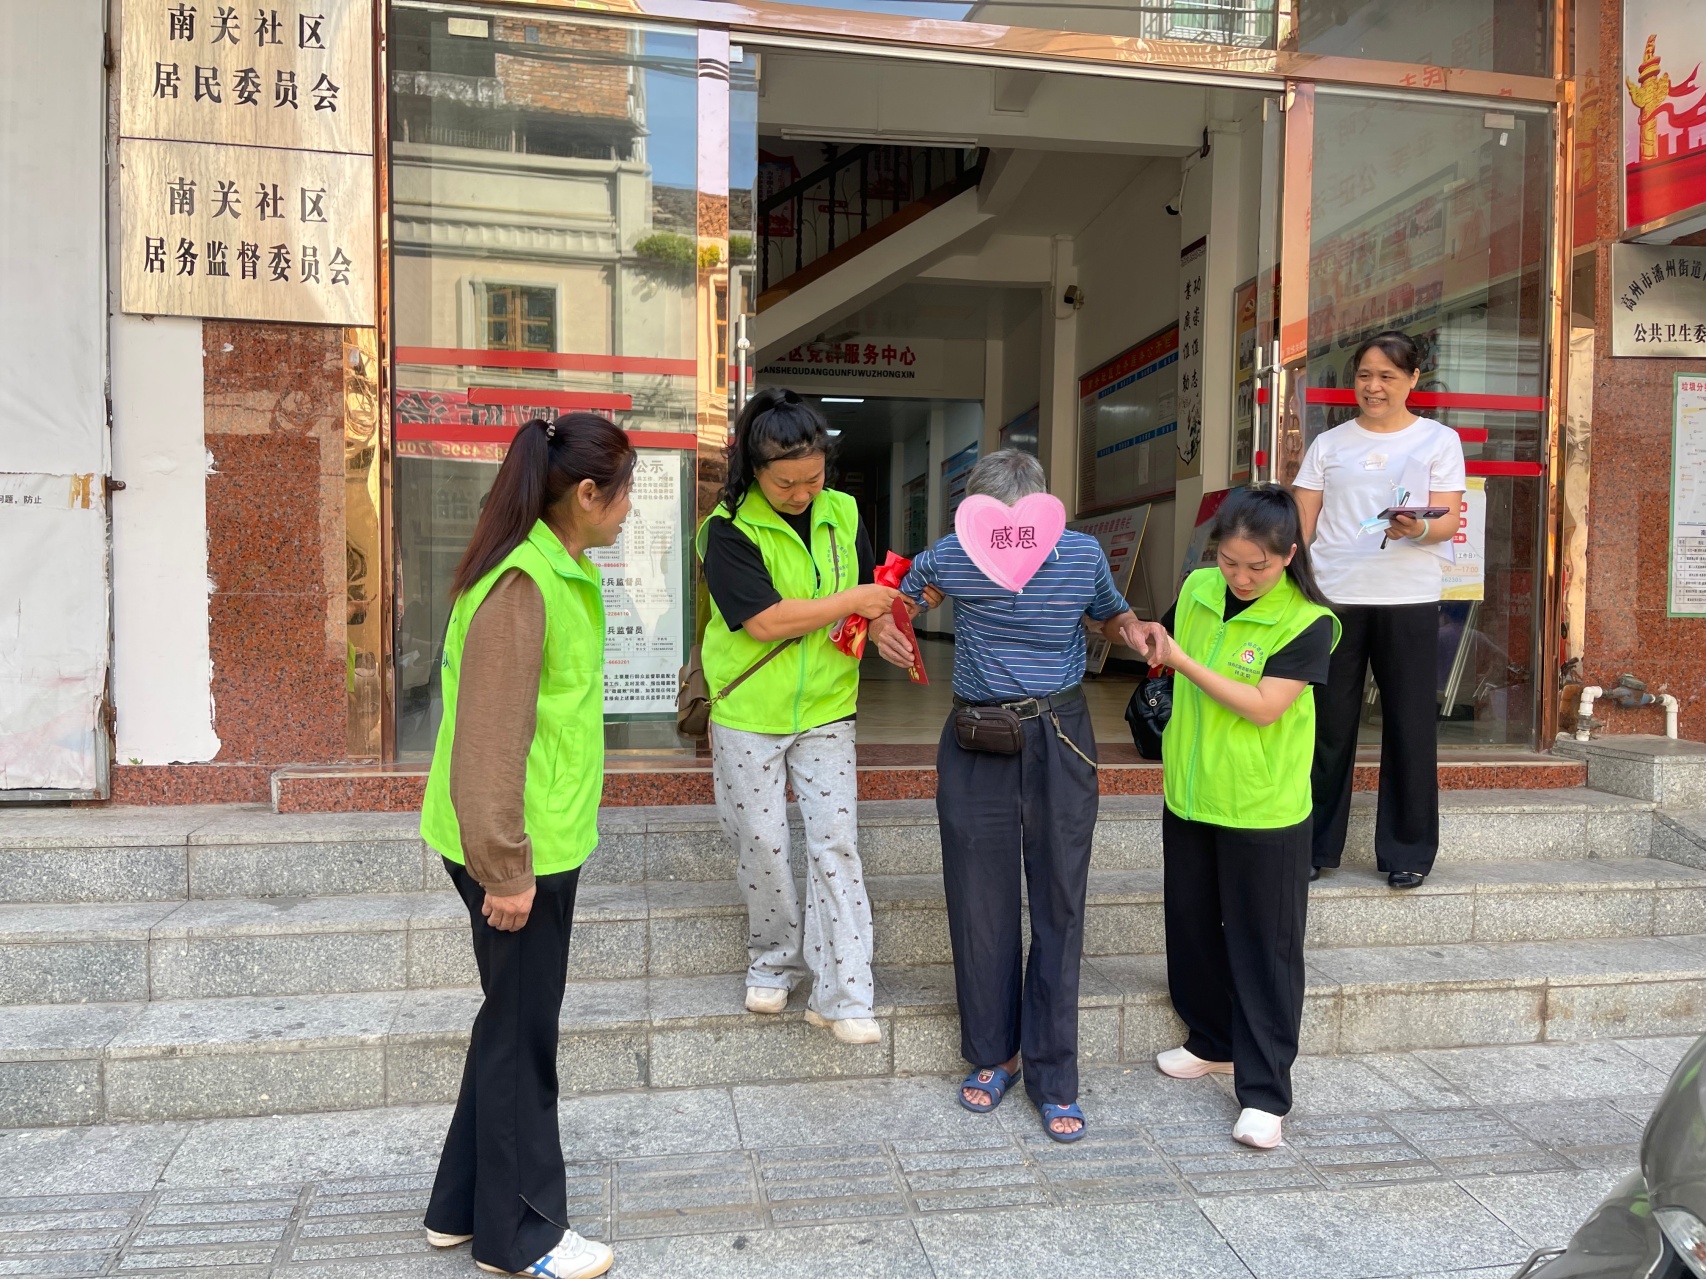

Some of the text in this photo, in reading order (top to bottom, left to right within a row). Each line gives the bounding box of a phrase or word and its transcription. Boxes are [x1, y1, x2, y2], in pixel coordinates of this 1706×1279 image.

[167, 2, 326, 49] 南关社区
[153, 61, 340, 112] 居民委员会
[167, 177, 328, 223] 南关社区
[144, 236, 352, 286] 居务监督委员会
[776, 343, 916, 366] 区党群服务中心
[758, 366, 915, 379] ANSHEQUDANGQUNFUWUZHONGXIN
[1681, 382, 1706, 392] 垃圾分
[636, 460, 664, 474] 公示
